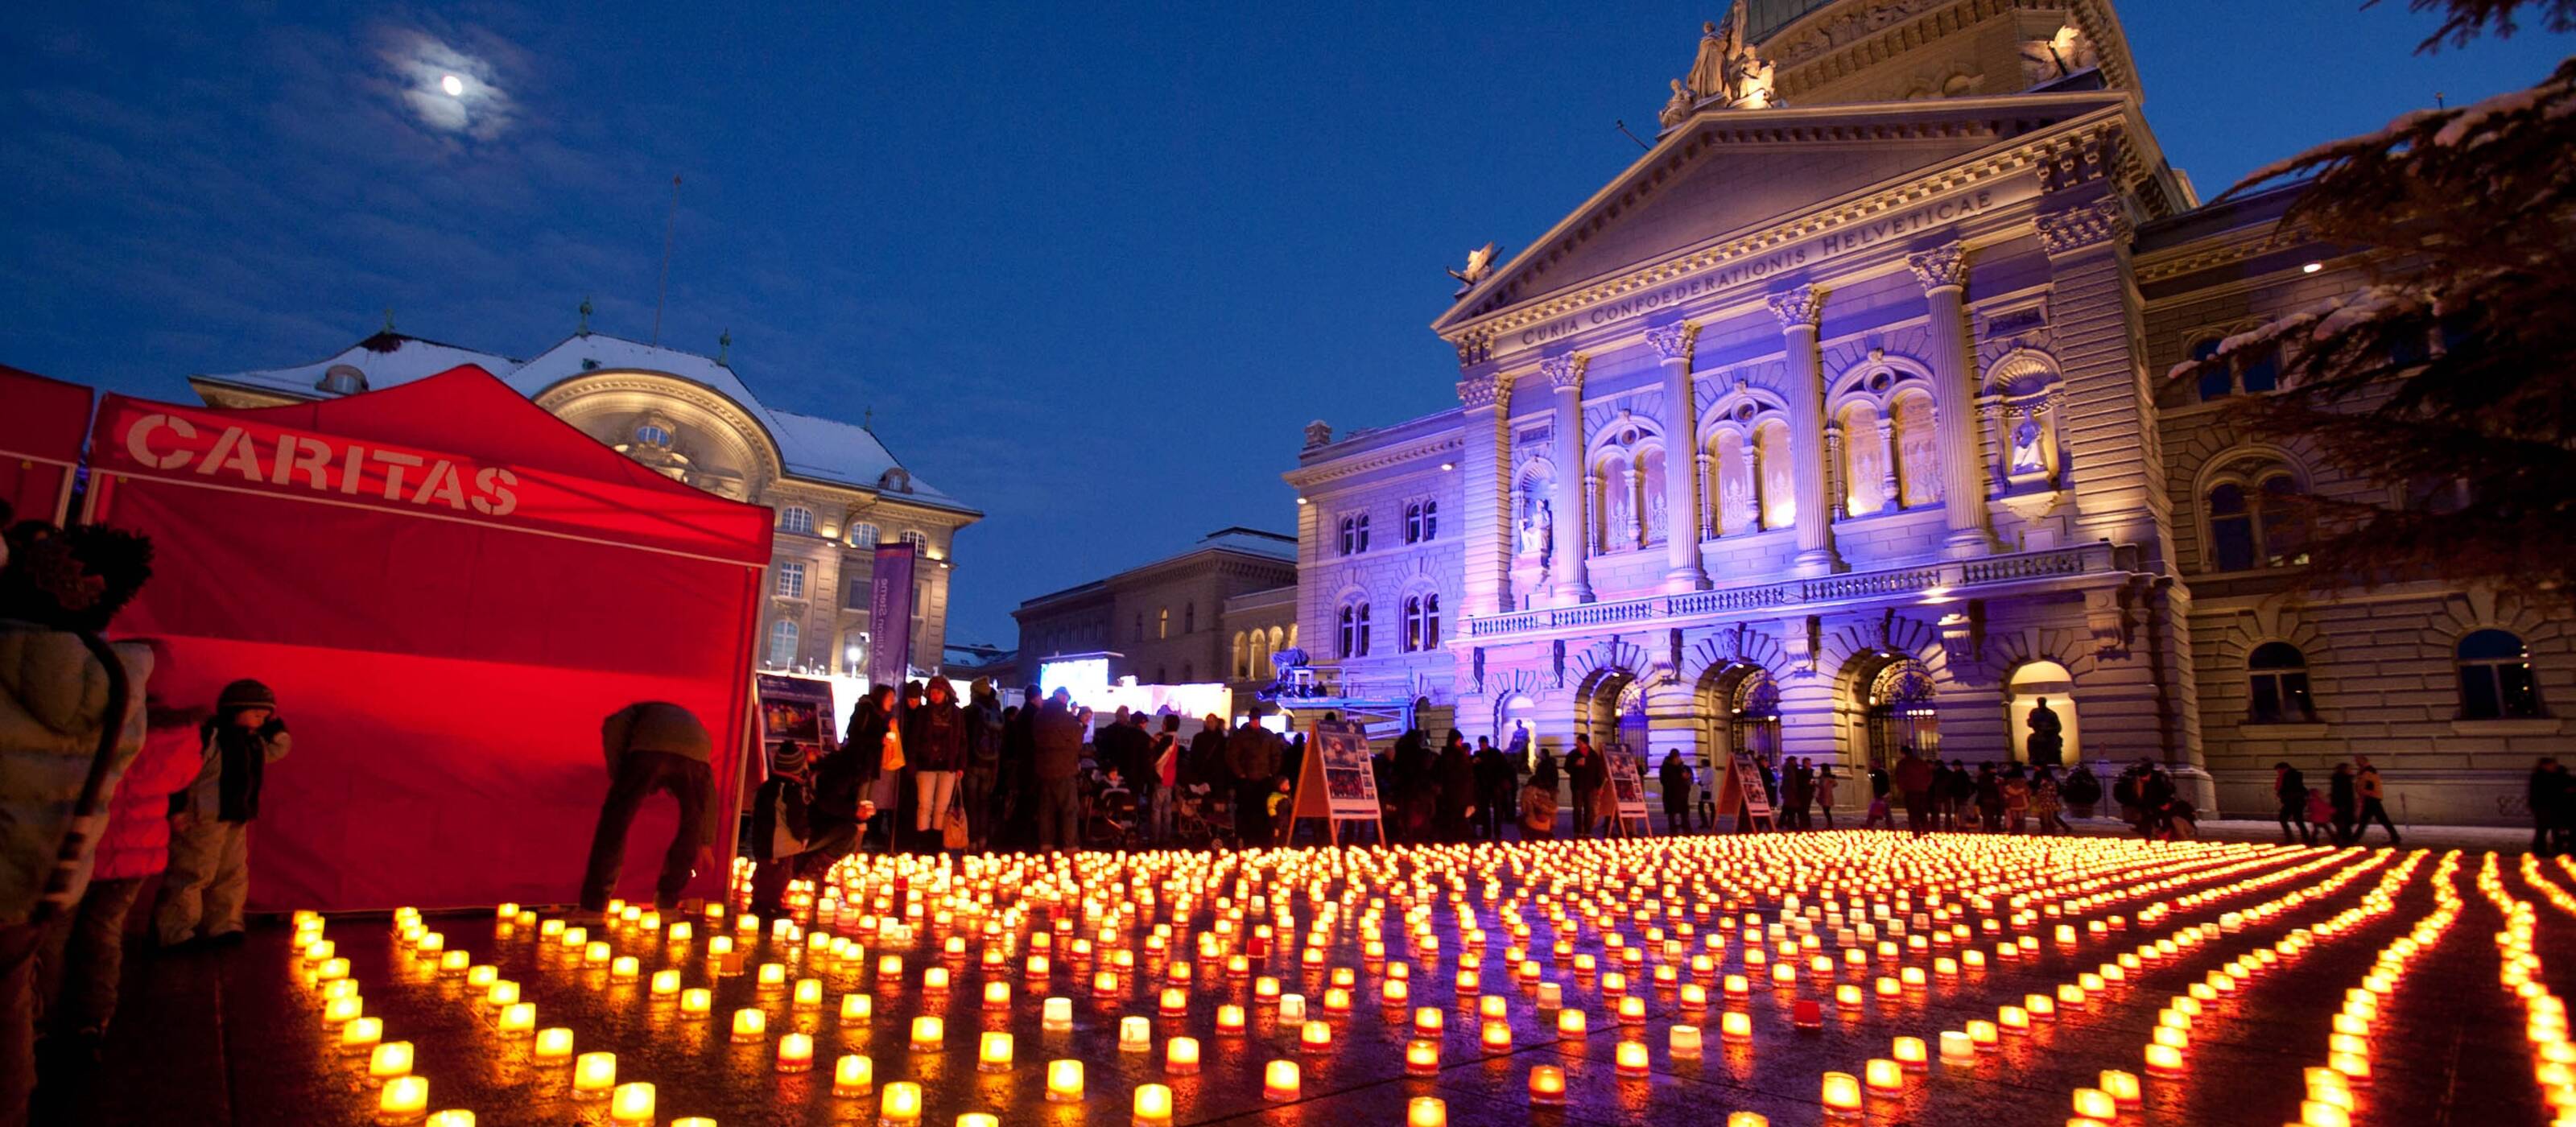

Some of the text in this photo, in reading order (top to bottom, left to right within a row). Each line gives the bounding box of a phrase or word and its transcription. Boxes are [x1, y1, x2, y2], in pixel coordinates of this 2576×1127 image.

[1521, 192, 1992, 346] CURIA CONFOEDERATIONIS HELVETICAE
[126, 414, 518, 517] CARITAS
